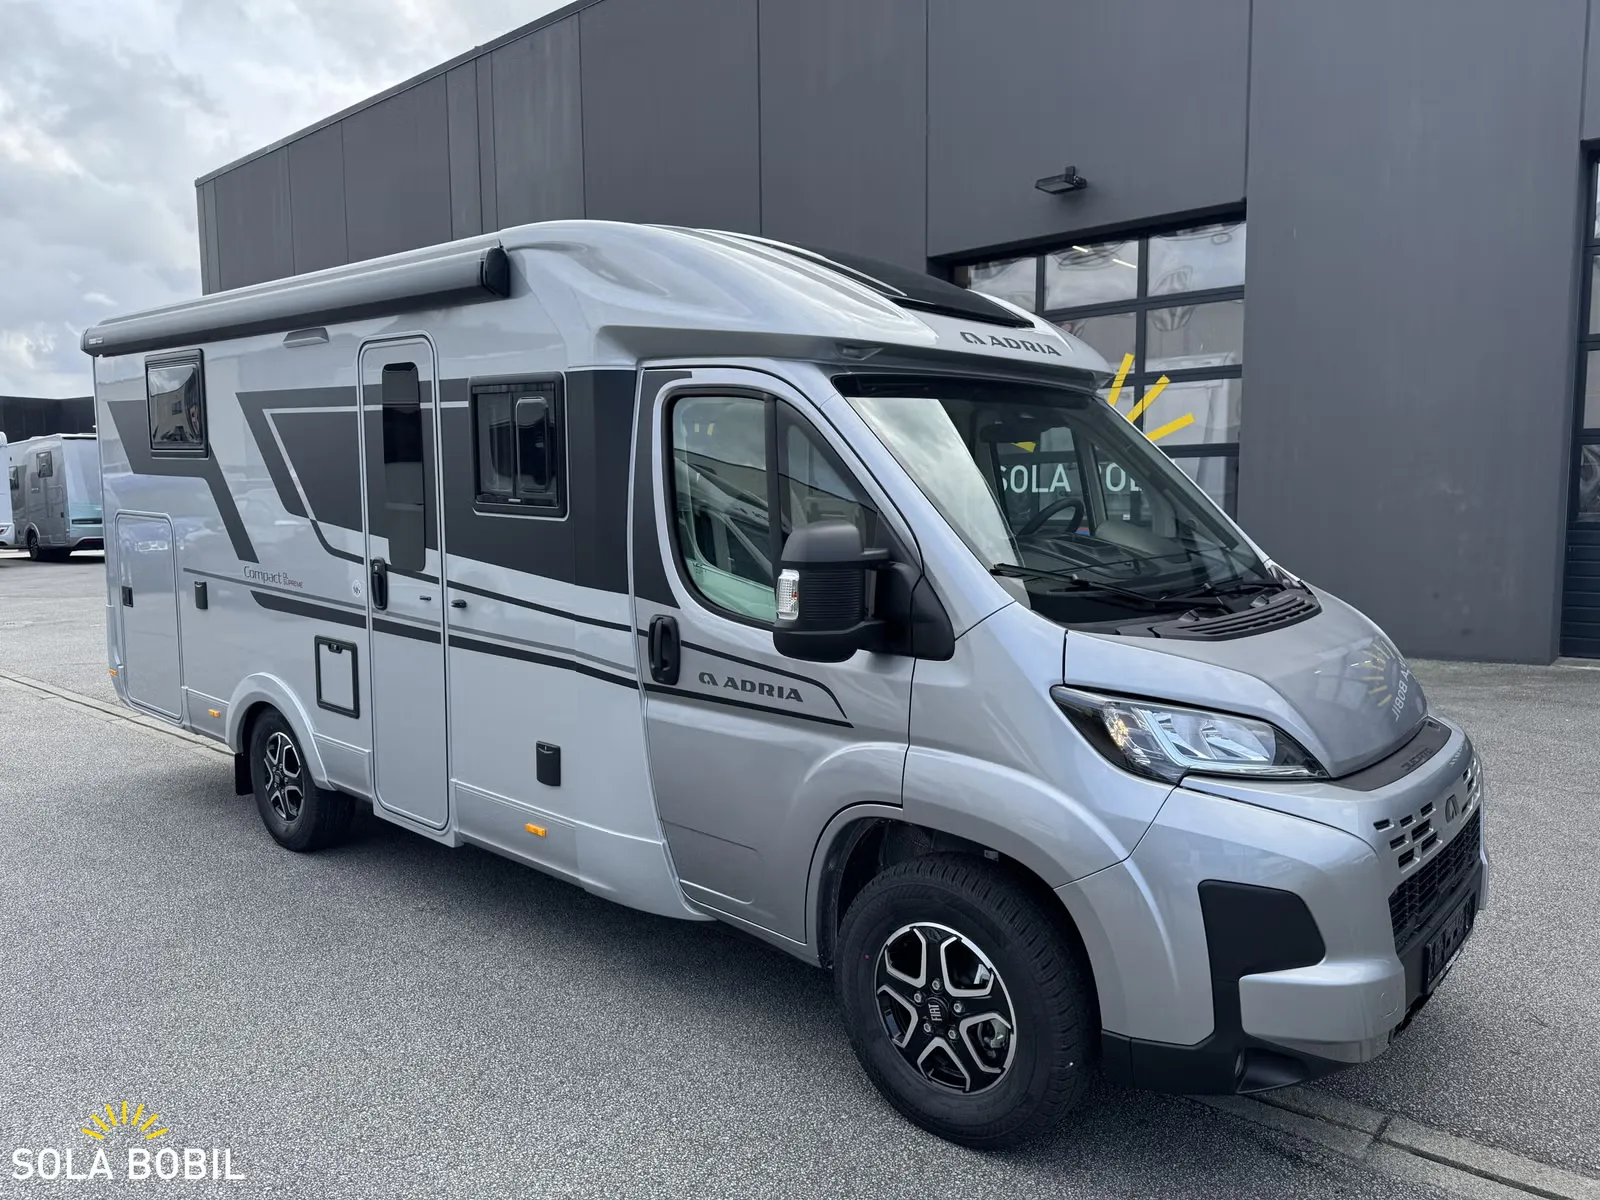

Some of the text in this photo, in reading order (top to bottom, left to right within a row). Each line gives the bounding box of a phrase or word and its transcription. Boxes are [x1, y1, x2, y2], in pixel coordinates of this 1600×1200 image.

[988, 335, 1062, 357] ADRIA
[244, 566, 282, 583] Compact
[723, 676, 804, 703] ADRIA
[928, 1004, 942, 1021] FIAT
